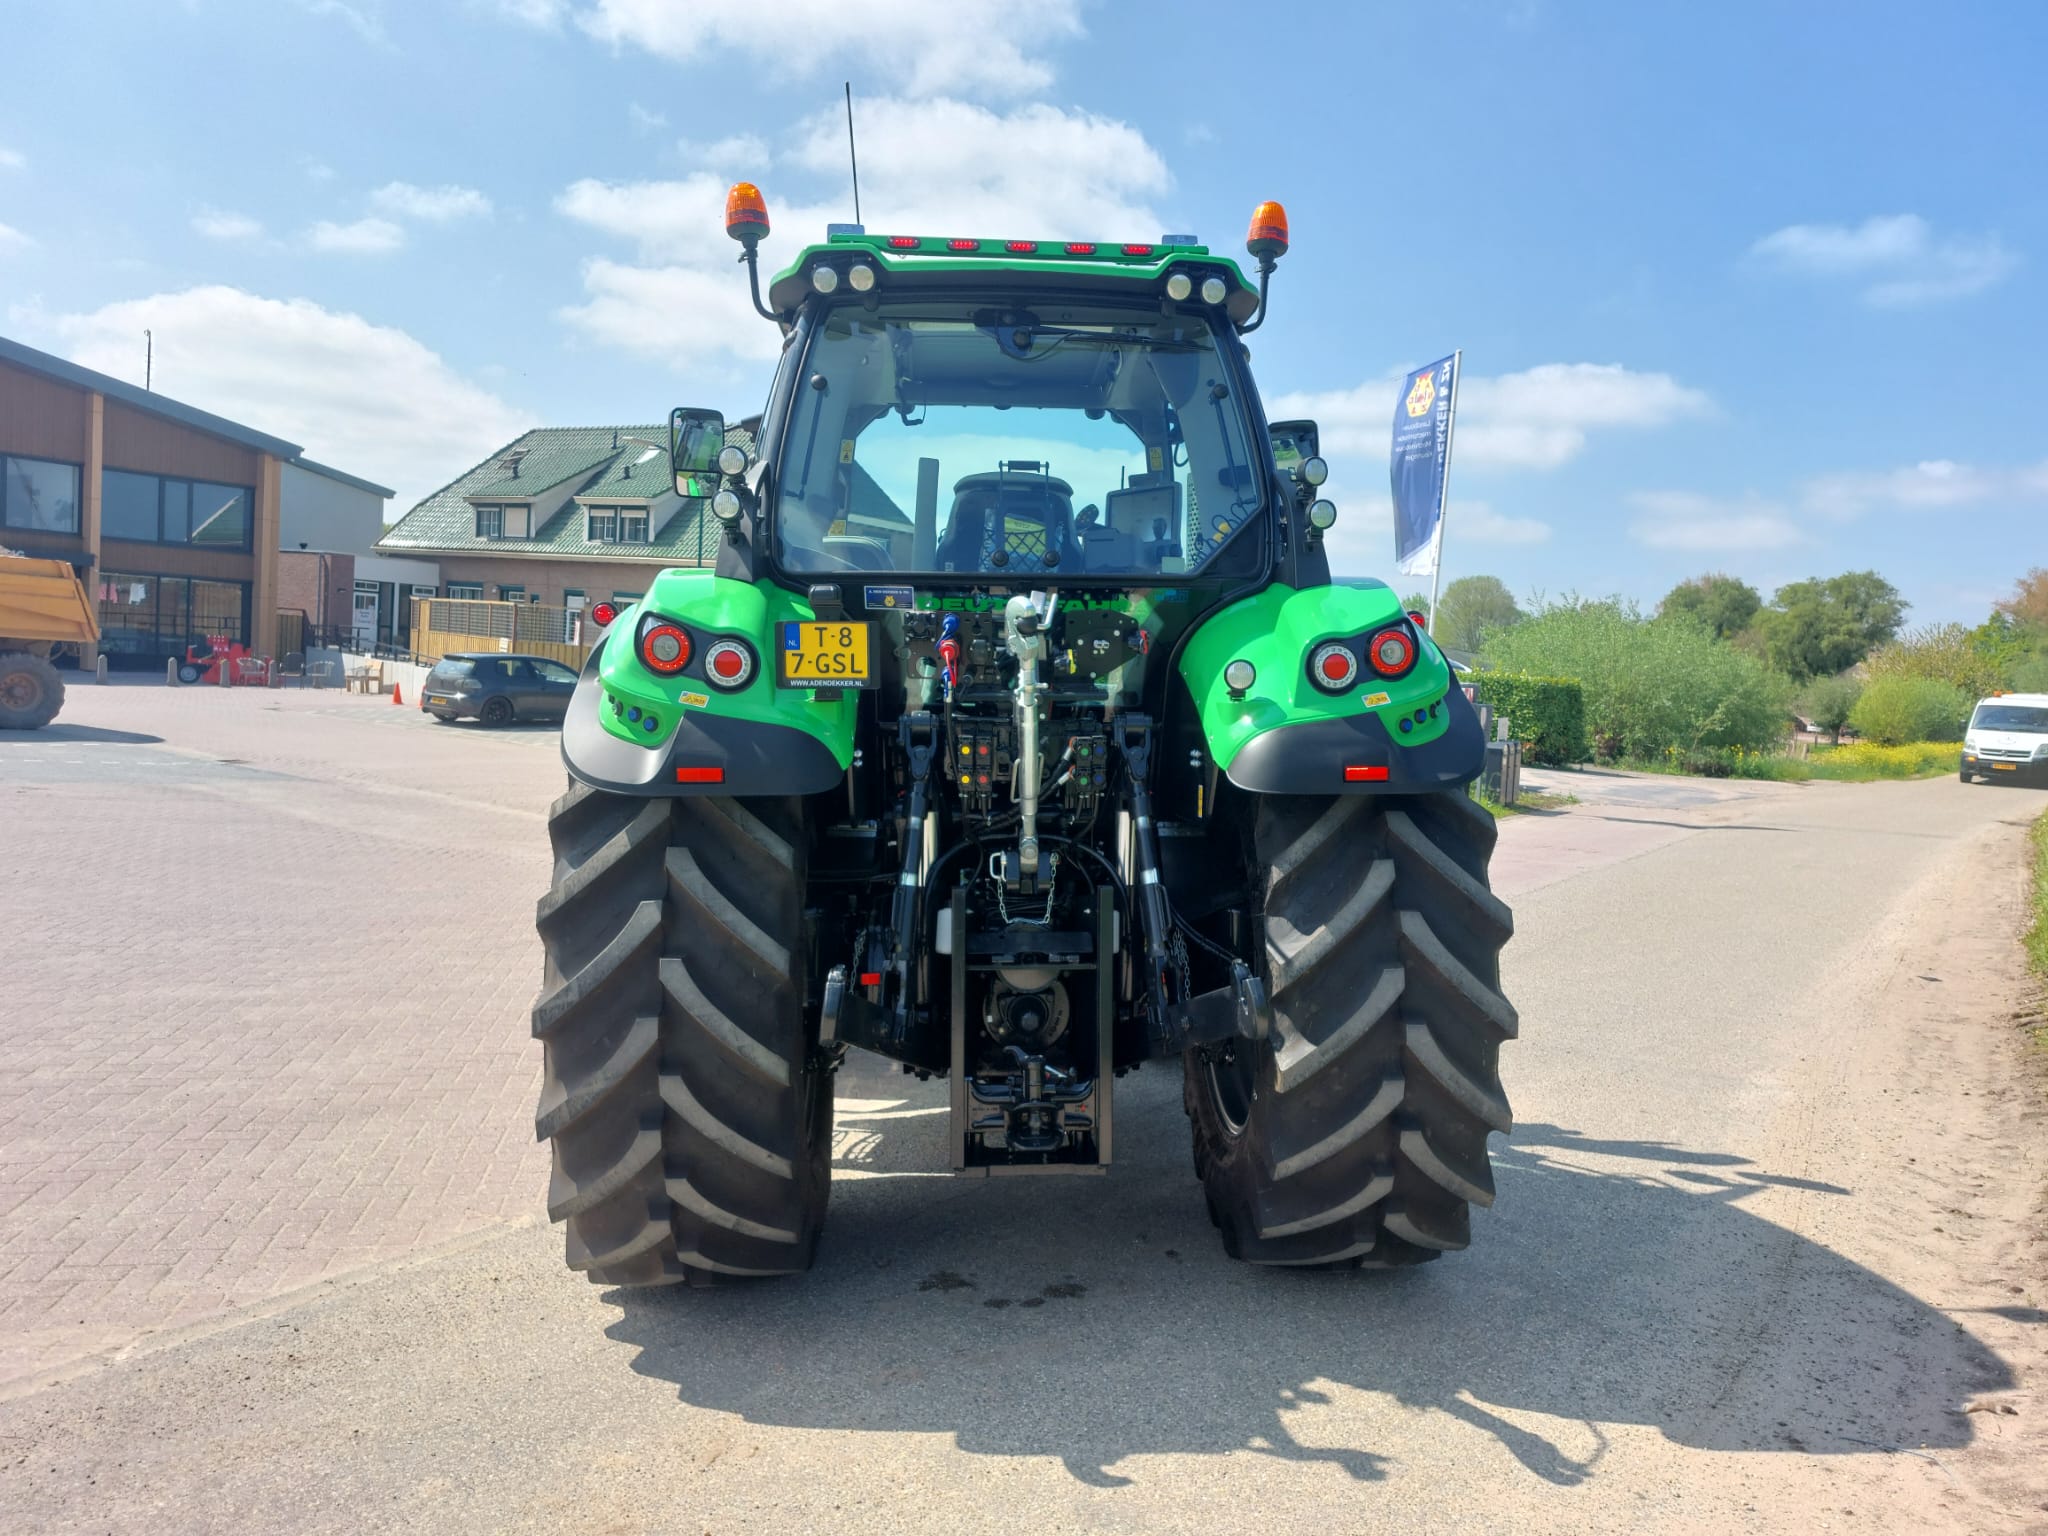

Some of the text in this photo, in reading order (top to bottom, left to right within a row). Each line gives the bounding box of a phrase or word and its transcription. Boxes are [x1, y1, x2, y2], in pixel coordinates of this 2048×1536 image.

[916, 597, 1007, 612] DEUT
[788, 639, 798, 647] NL
[814, 626, 852, 648] T-8
[791, 652, 864, 674] 7-GSL
